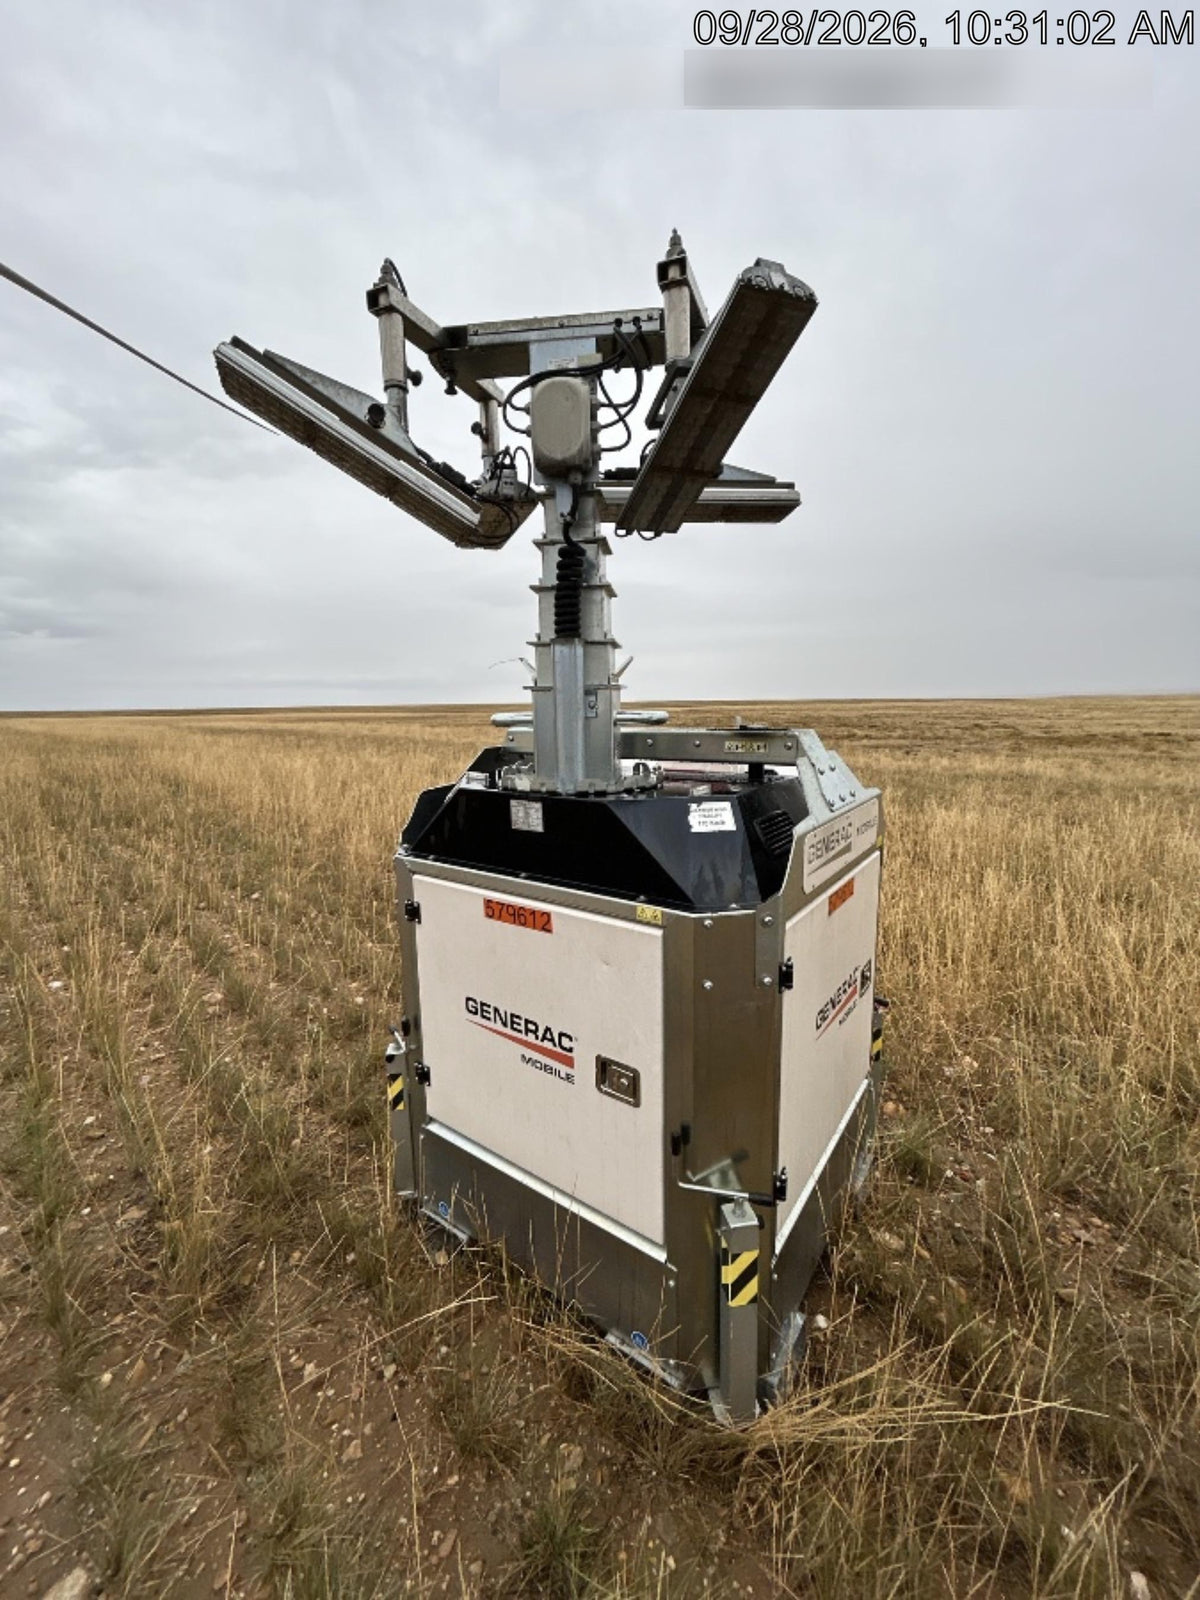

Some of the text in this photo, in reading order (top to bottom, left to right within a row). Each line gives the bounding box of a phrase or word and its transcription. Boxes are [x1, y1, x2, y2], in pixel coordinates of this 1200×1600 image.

[808, 822, 853, 864] GENERAC
[485, 900, 552, 933] 579612
[815, 967, 859, 1031] GENERAC
[465, 996, 574, 1053] GENERAC
[520, 1053, 575, 1085] MOBILE
